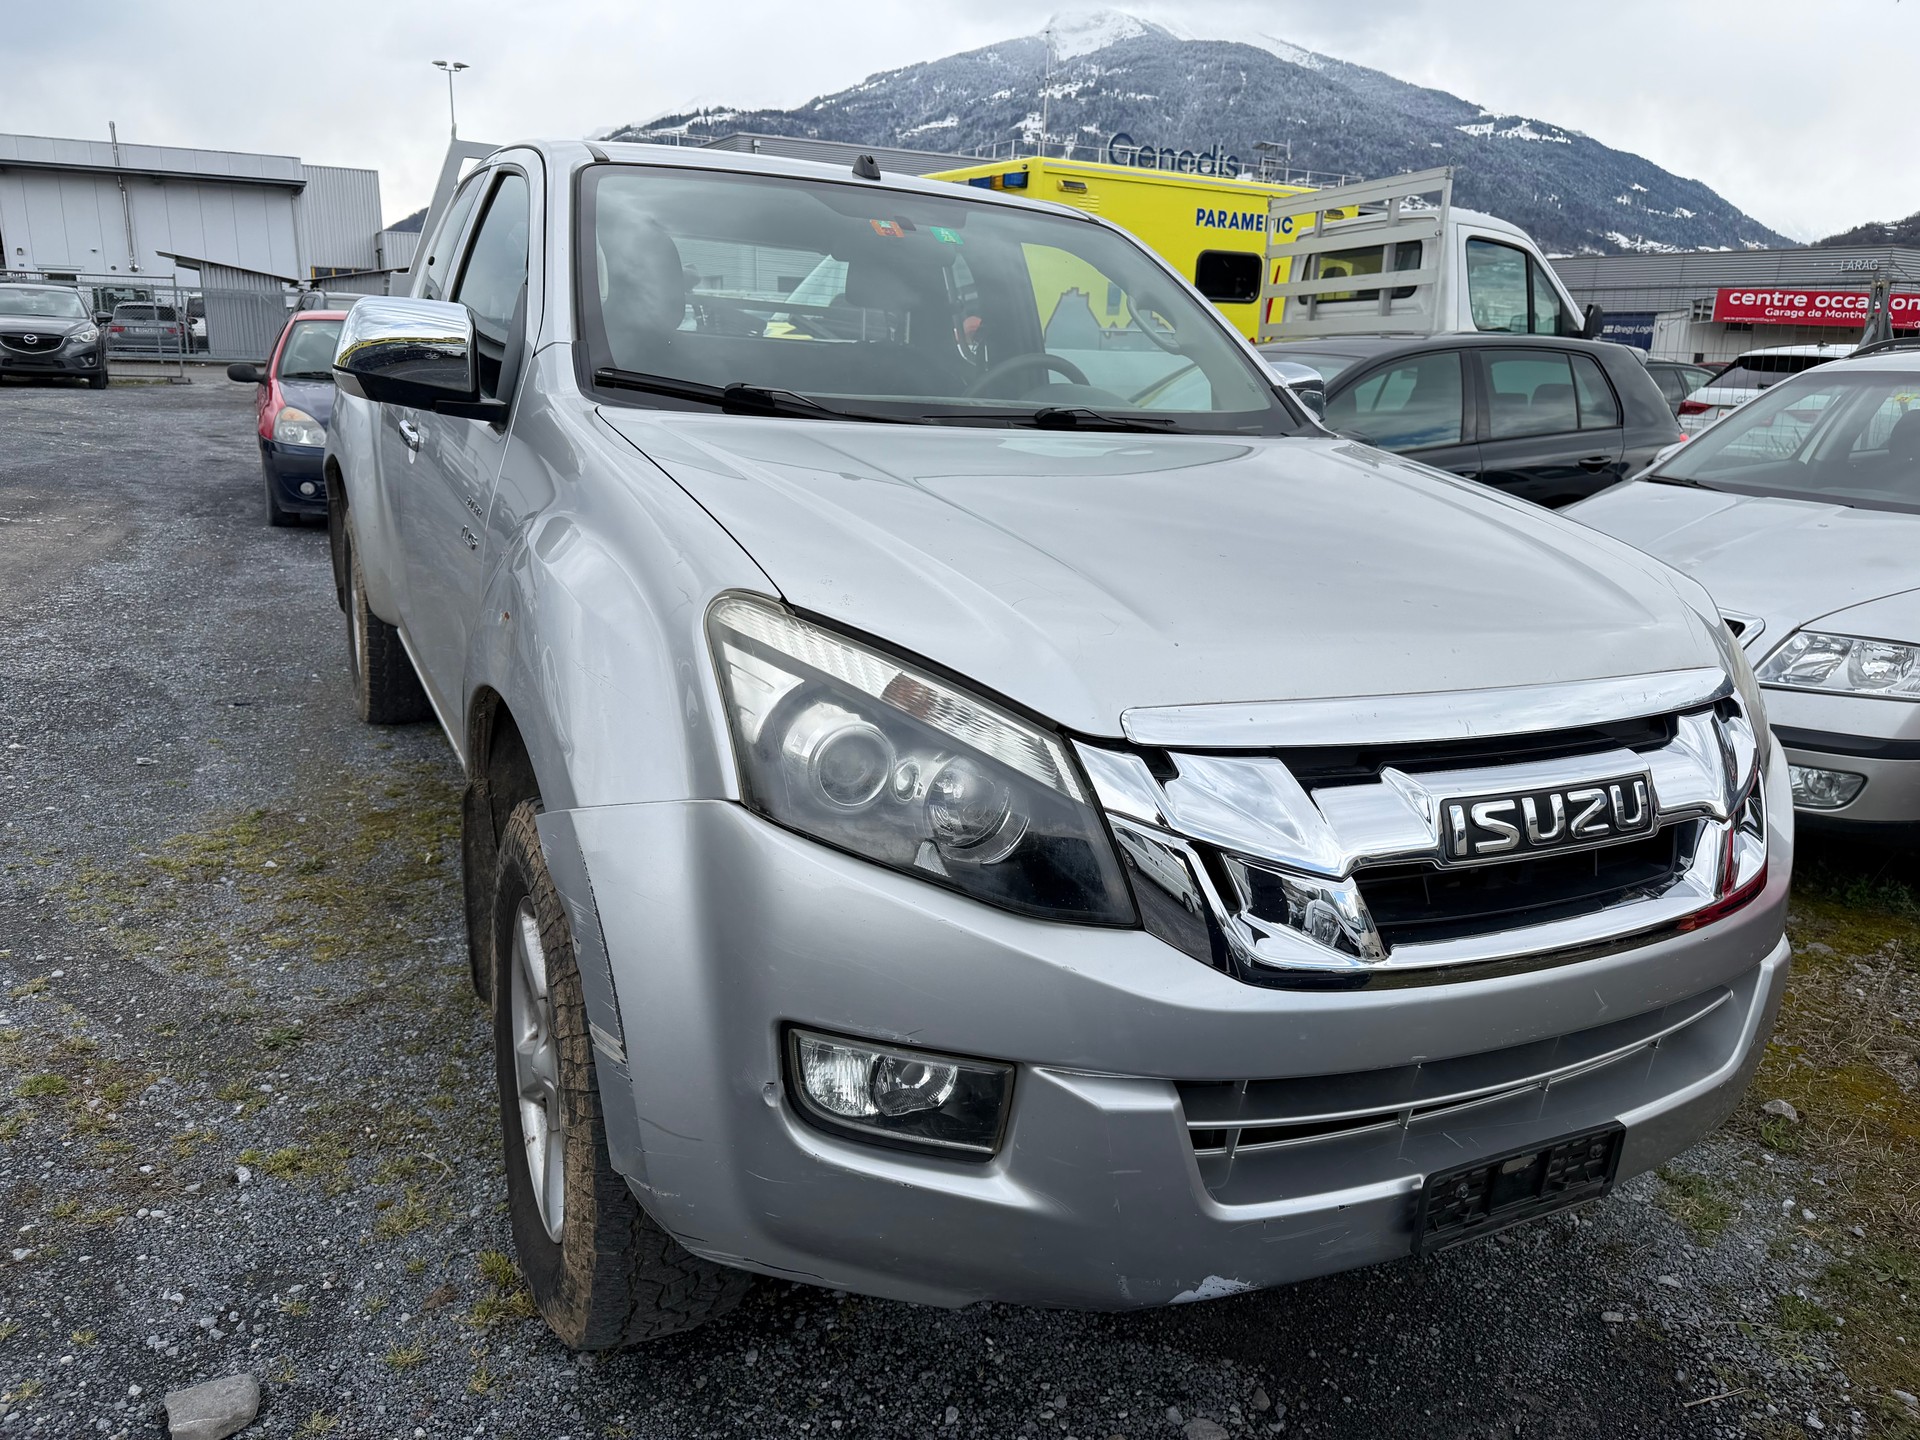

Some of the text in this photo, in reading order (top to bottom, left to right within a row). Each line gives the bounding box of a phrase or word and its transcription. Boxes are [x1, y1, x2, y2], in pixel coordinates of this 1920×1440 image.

[1107, 132, 1238, 176] Genedis
[1840, 259, 1878, 271] LARAG
[1729, 291, 1920, 311] centre occaon
[1765, 308, 1805, 318] Garage
[1808, 309, 1822, 317] de
[1825, 310, 1867, 319] Monthe
[1449, 780, 1648, 856] ISUZU
